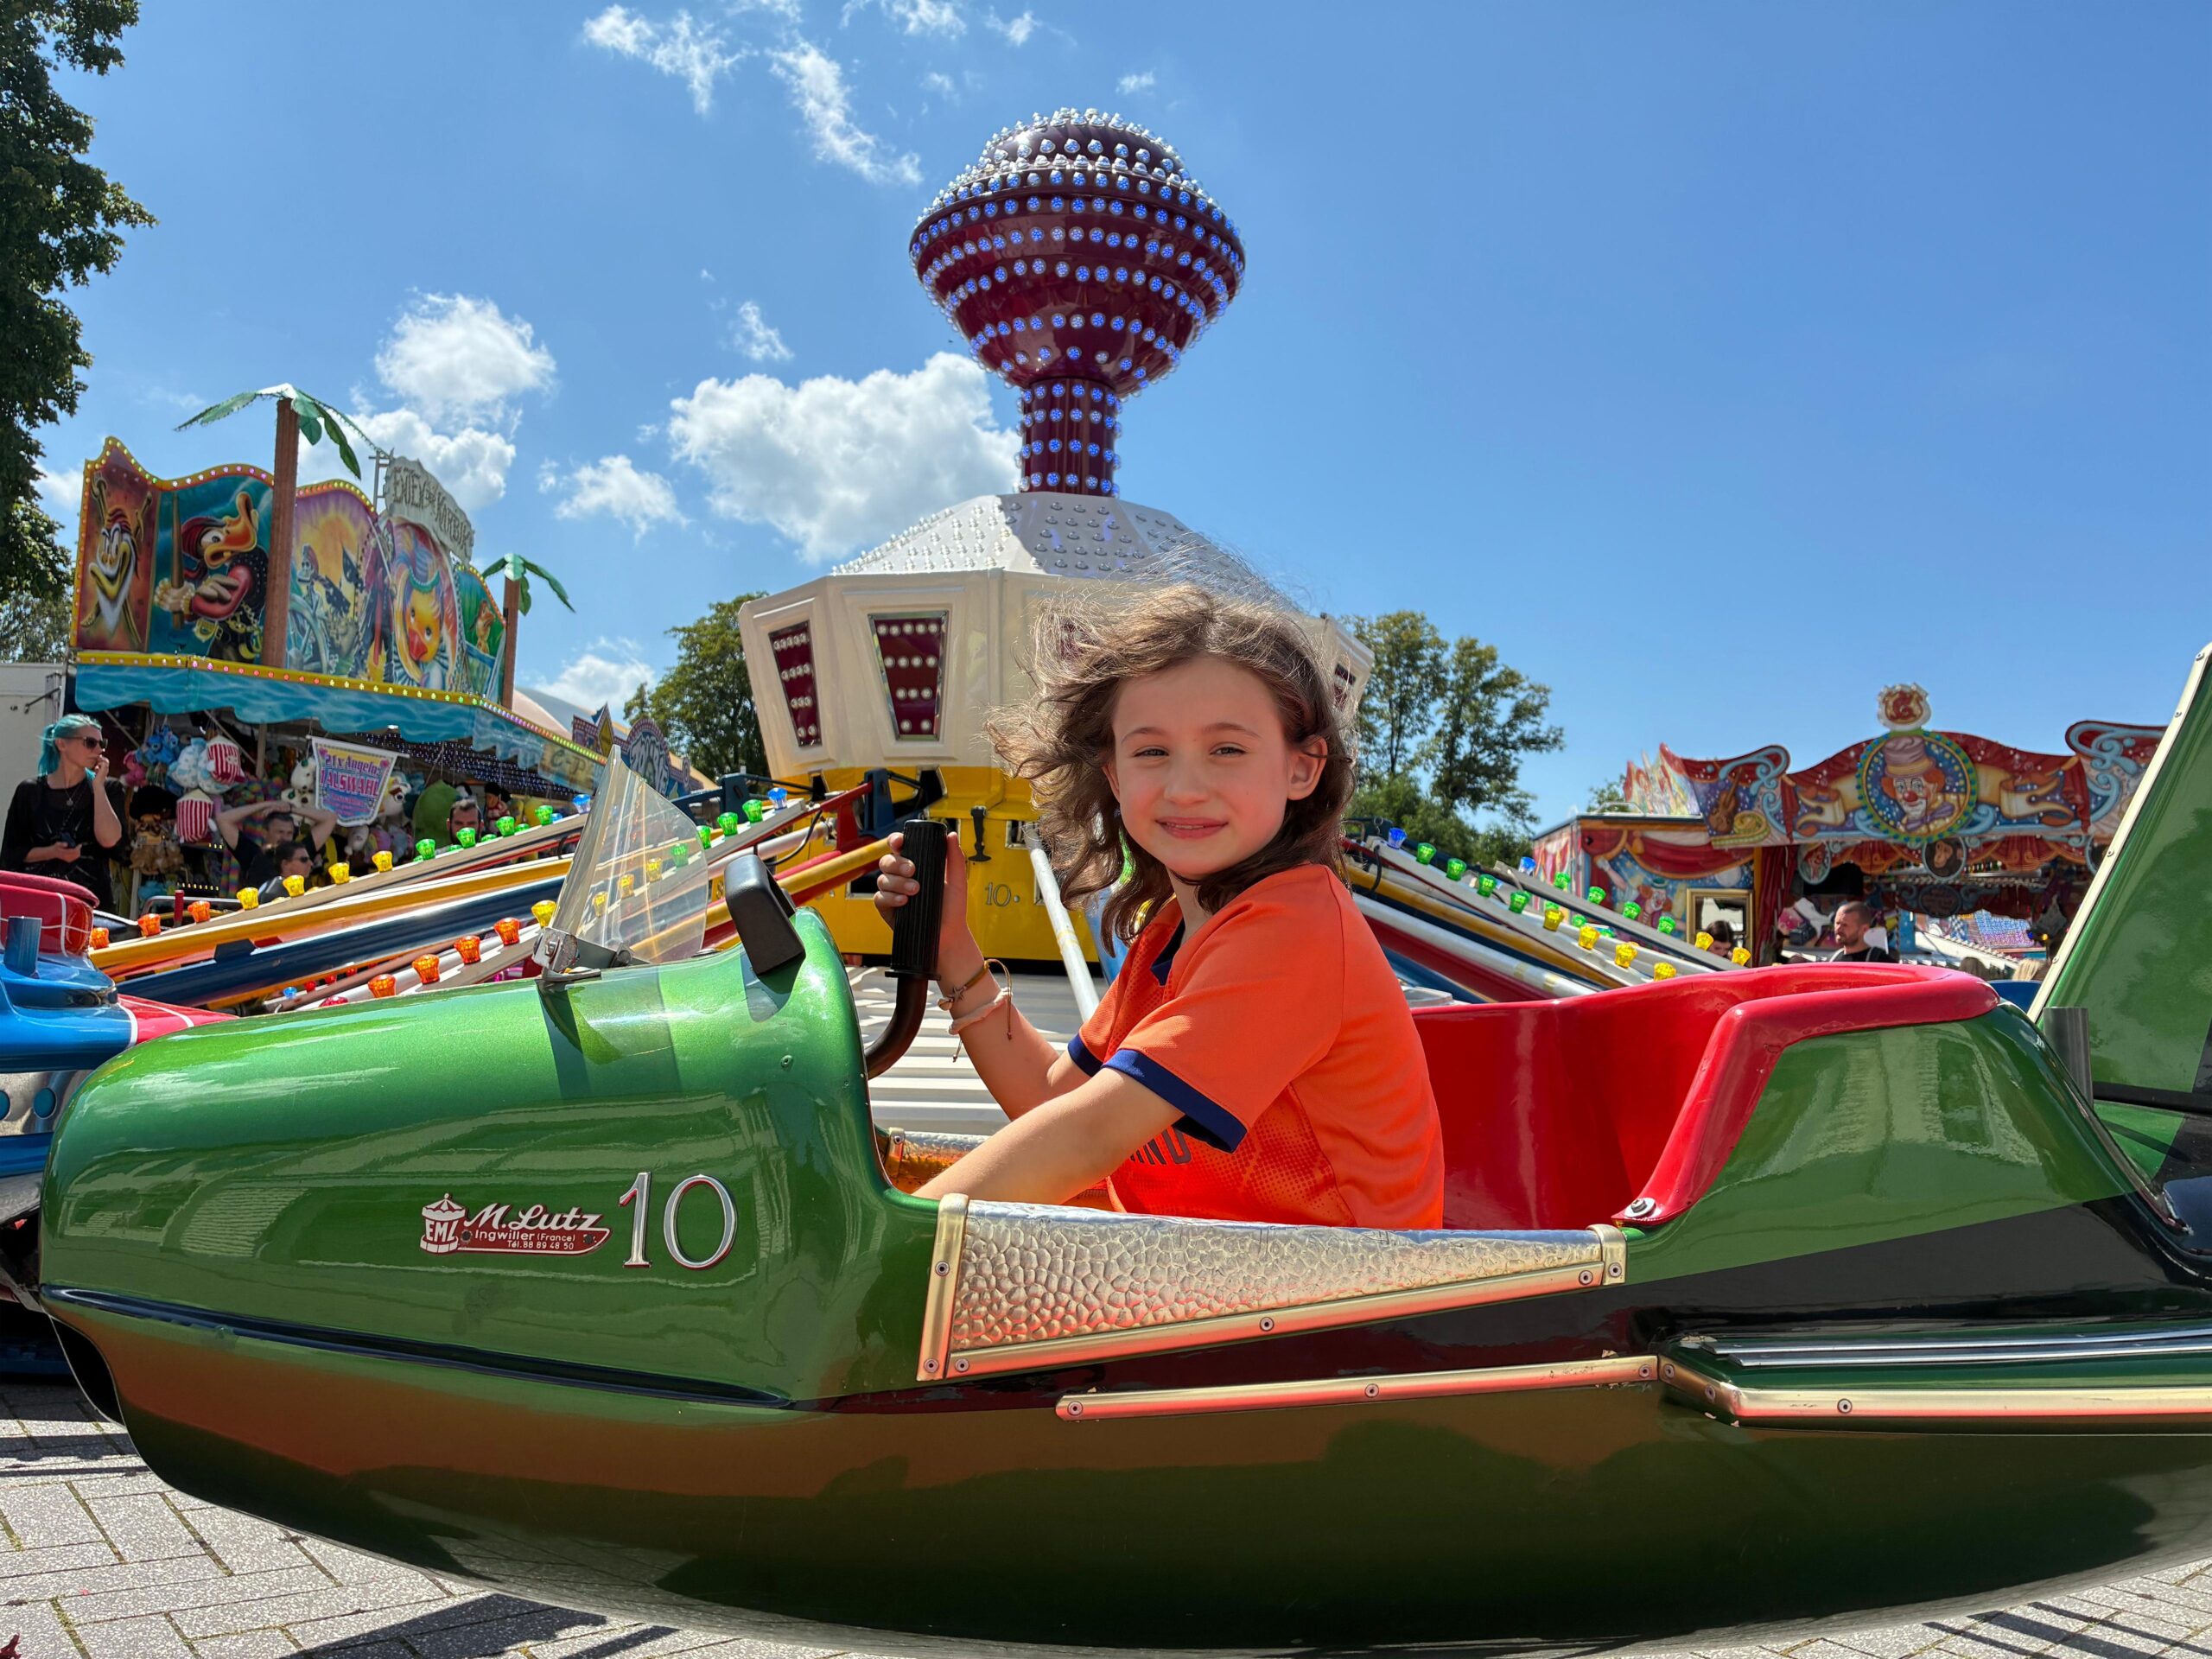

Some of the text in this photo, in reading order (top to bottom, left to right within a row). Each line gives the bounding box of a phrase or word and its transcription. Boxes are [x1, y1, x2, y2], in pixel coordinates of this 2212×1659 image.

[984, 881, 1012, 907] 10
[425, 1218, 459, 1243] EML
[619, 1172, 738, 1271] 10
[474, 1230, 575, 1242] Ingwiller (France)
[536, 1241, 547, 1249] 89
[563, 1242, 574, 1250] 50
